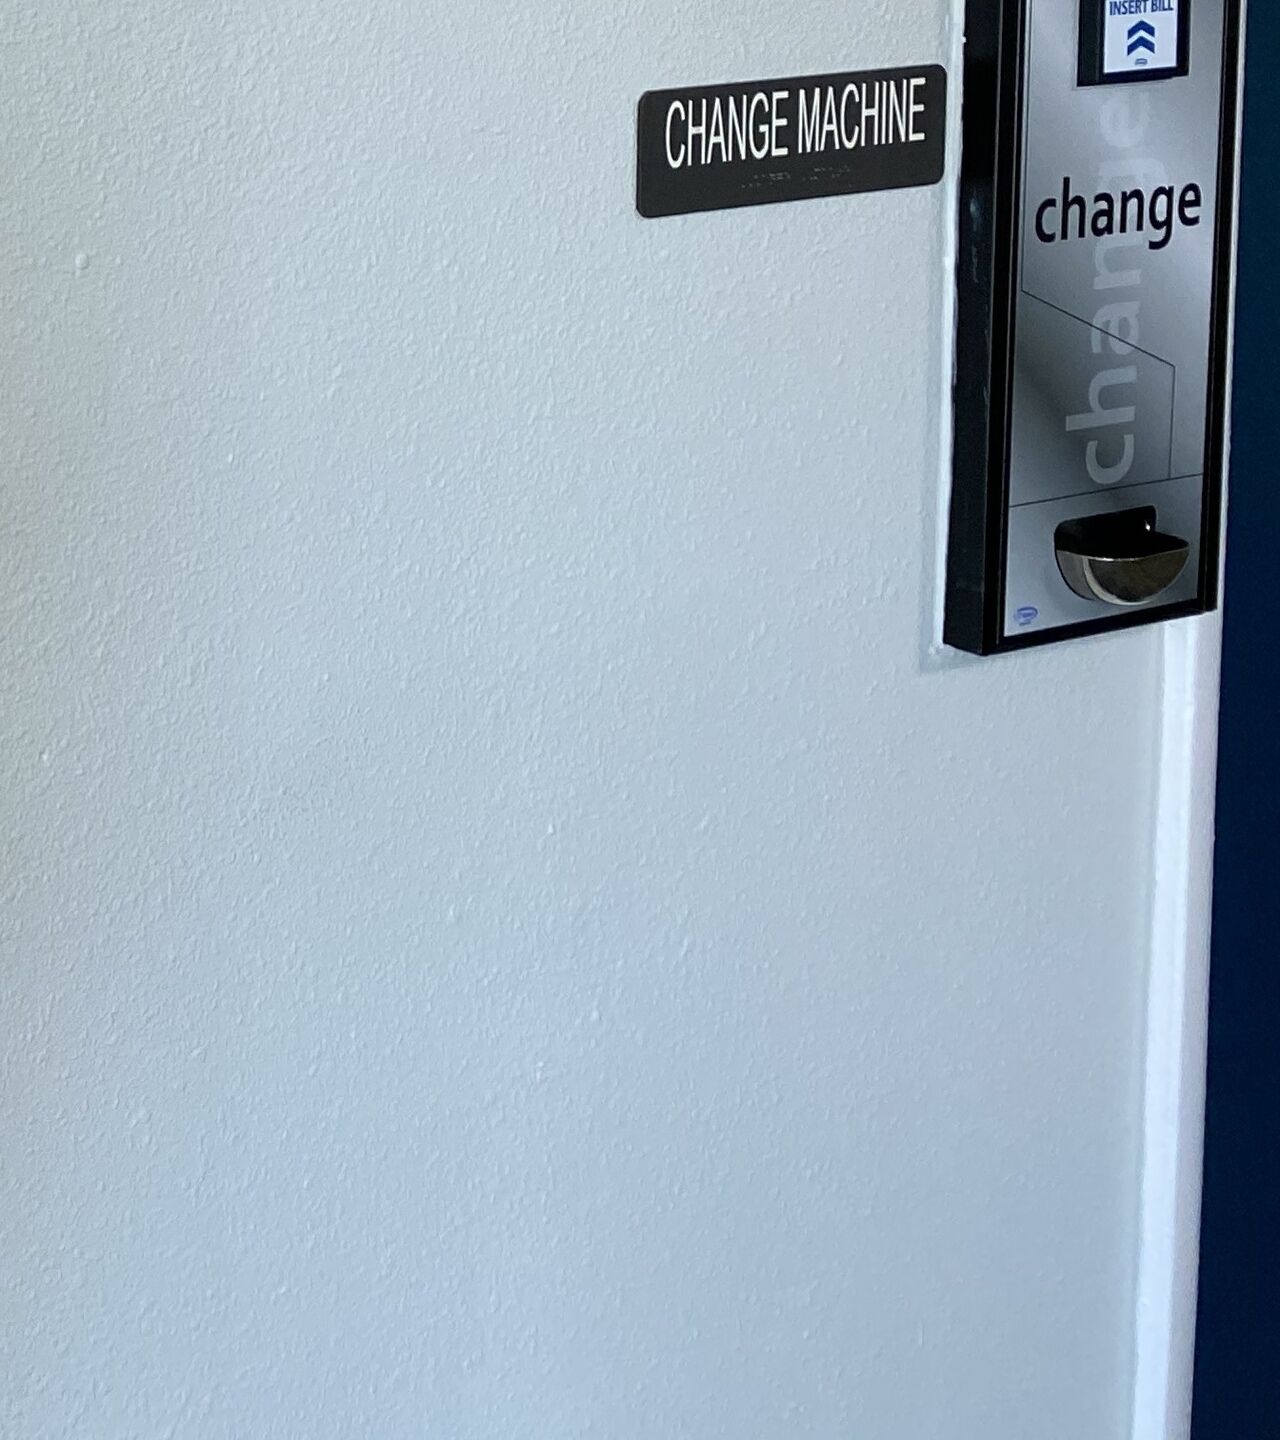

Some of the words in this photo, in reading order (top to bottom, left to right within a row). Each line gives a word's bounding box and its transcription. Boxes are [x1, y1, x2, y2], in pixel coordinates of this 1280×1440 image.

[1109, 0, 1149, 16] INSERT
[665, 90, 789, 169] CHANGE
[798, 77, 926, 154] MACHINE
[1035, 176, 1201, 250] change
